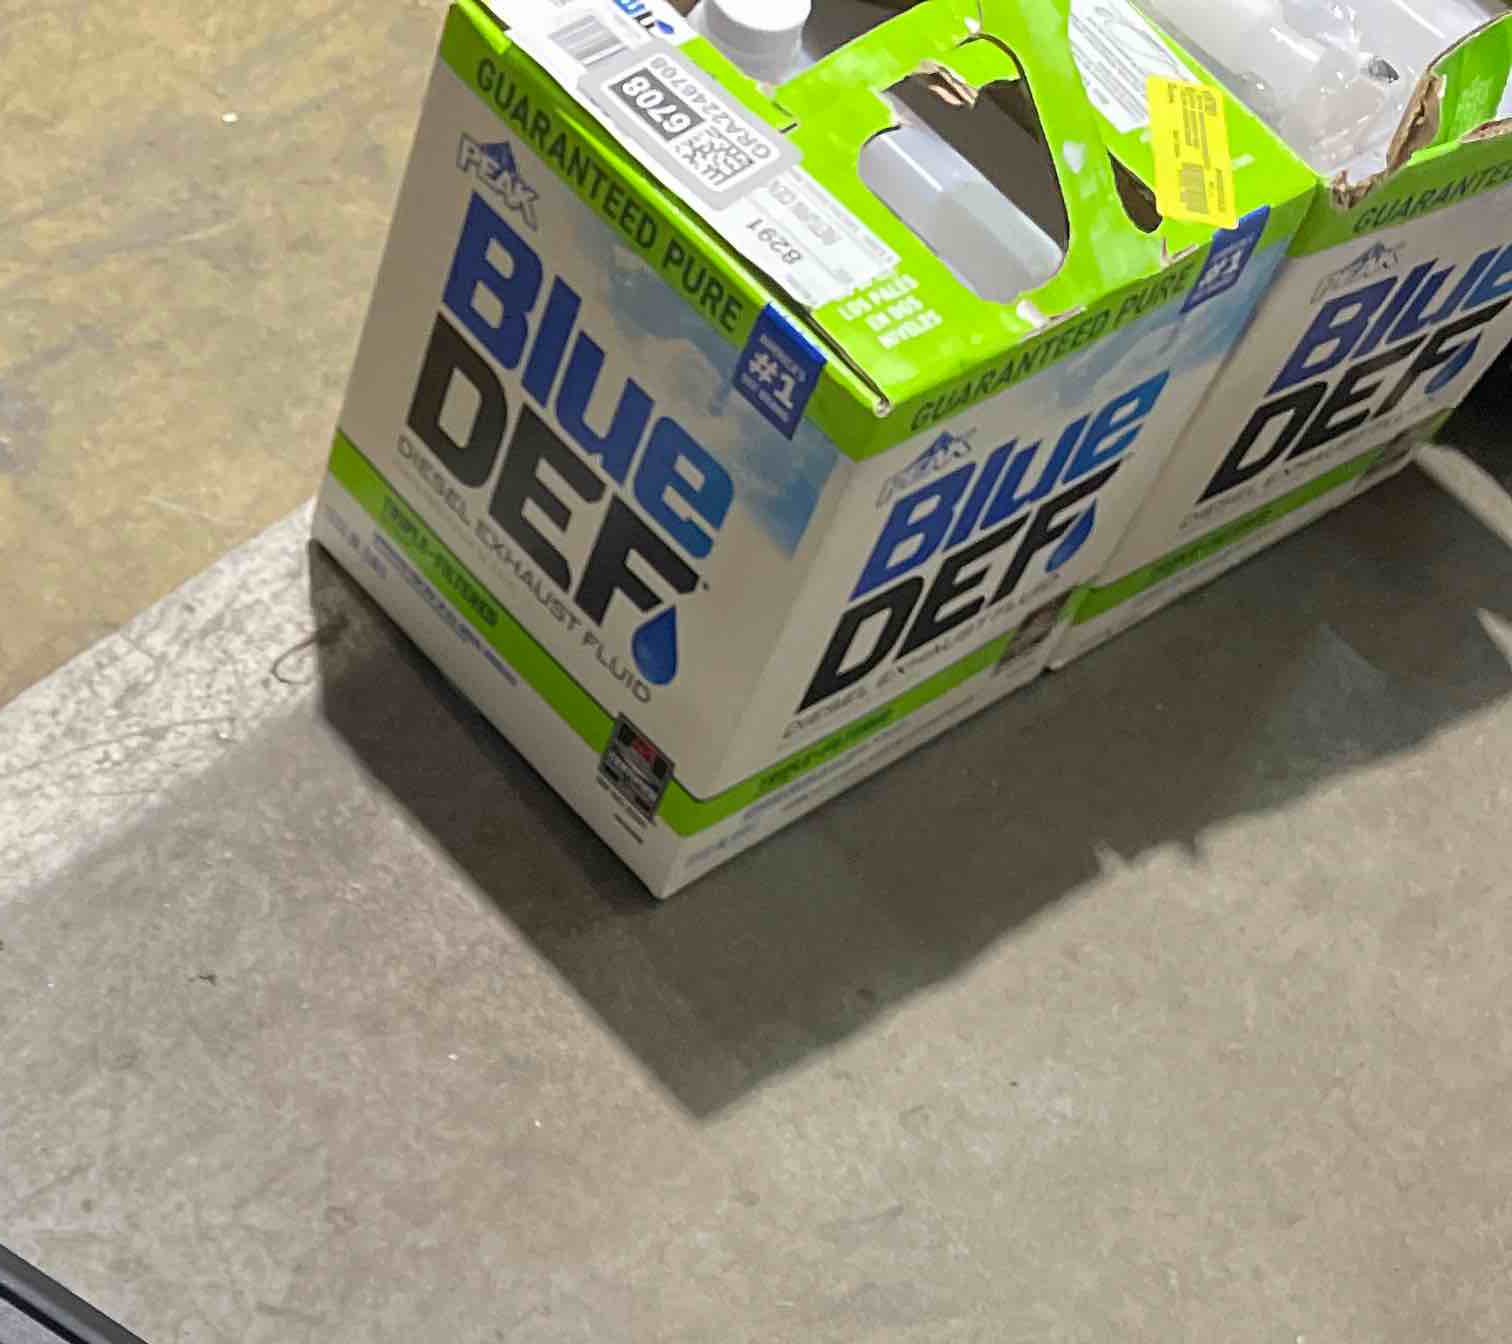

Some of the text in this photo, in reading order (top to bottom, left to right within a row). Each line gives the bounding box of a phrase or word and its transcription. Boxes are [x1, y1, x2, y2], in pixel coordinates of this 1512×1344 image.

[472, 56, 664, 253] GUARANTEED
[657, 238, 745, 336] PURE
[619, 69, 694, 139] 6708
[441, 191, 735, 558] Blue
[910, 312, 1112, 430] GUARANTEED
[1110, 266, 1189, 330] PURE
[1204, 298, 1512, 500] DEF
[406, 312, 701, 628] DEF
[796, 457, 1131, 713] DEF
[849, 369, 1171, 600] Blue
[469, 519, 581, 634] EXHAUST
[577, 628, 655, 708] FLUID
